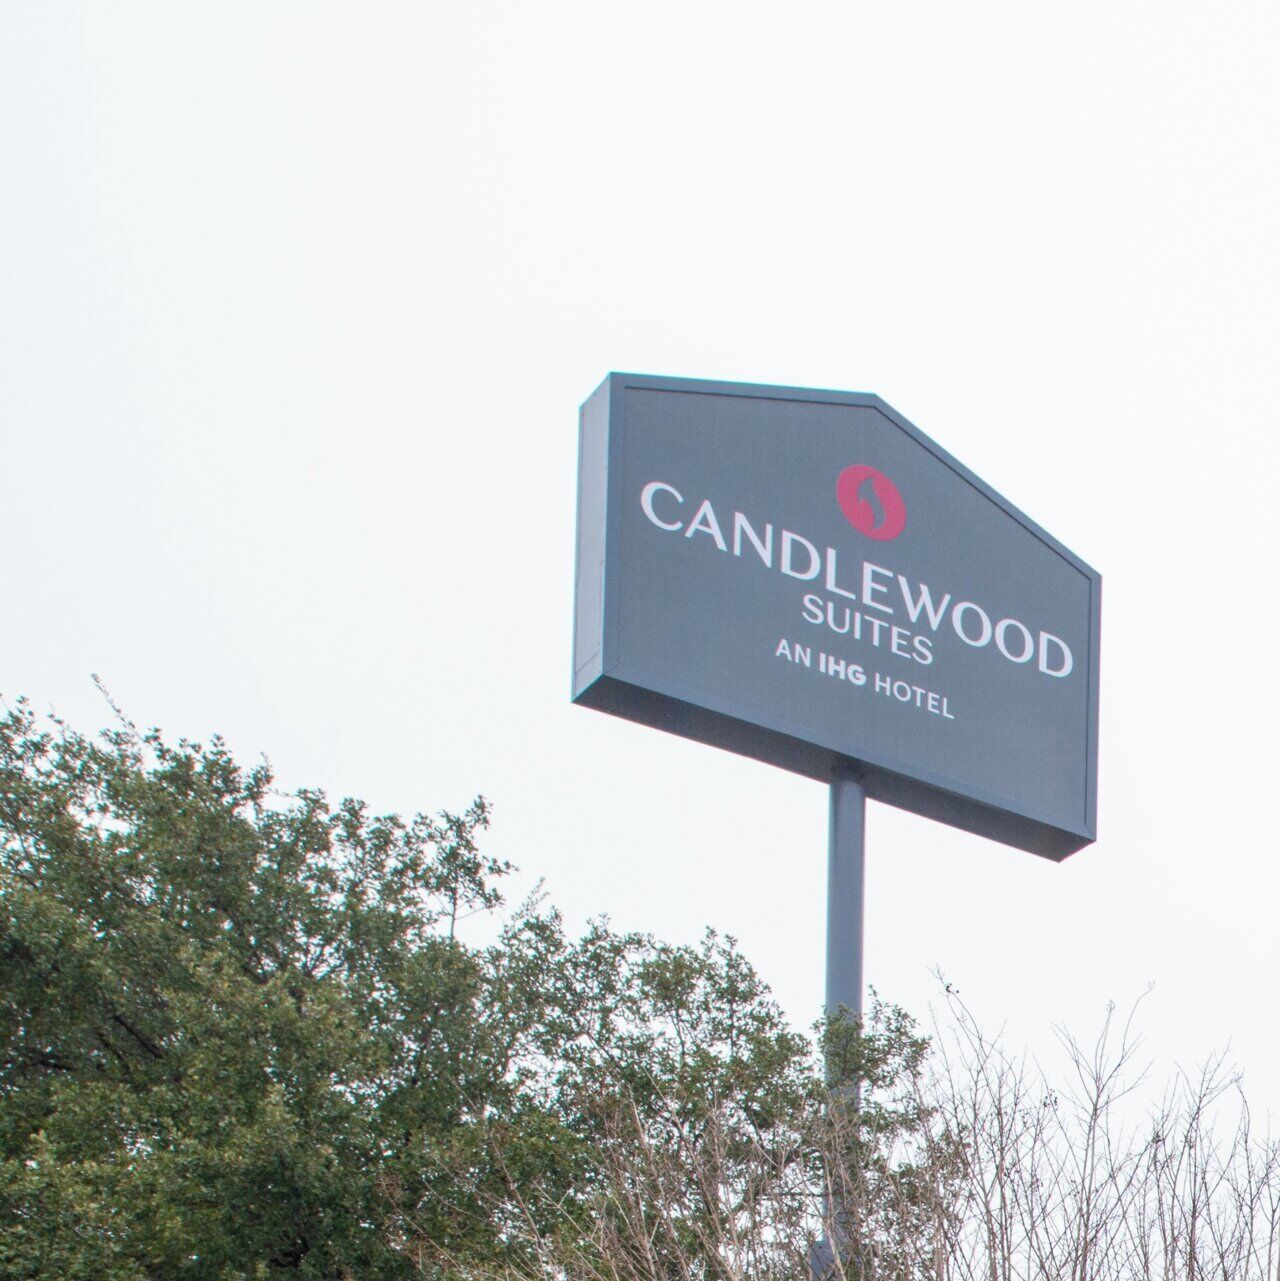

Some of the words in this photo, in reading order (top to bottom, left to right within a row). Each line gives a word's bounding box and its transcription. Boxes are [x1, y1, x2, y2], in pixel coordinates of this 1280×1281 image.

[640, 481, 1074, 678] CANDLEWOOD
[801, 594, 934, 666] SUITES
[775, 638, 812, 668] AN
[818, 652, 867, 686] IHG
[874, 672, 955, 720] HOTEL
